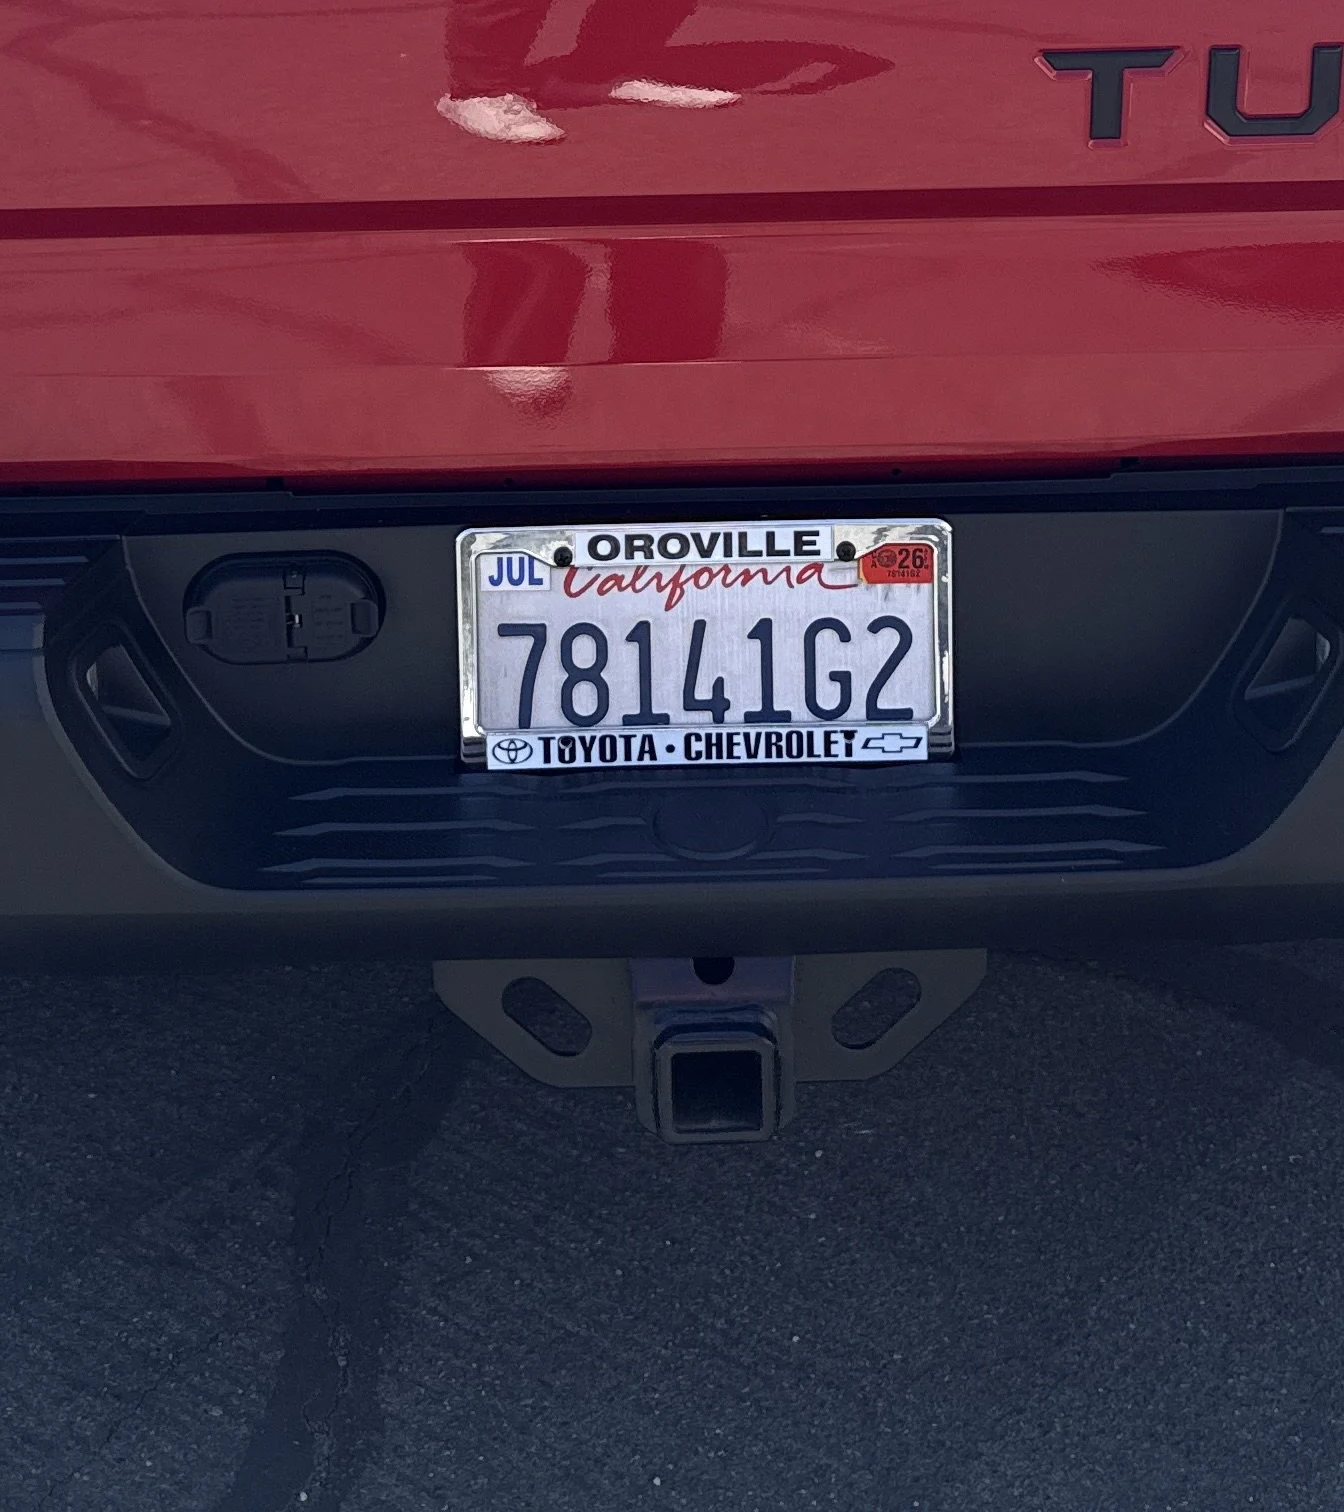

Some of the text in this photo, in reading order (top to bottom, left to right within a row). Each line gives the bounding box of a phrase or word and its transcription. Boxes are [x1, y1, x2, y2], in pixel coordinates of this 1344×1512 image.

[587, 530, 822, 561] OROVILLE
[897, 548, 924, 569] 26
[488, 555, 544, 587] JUL
[562, 561, 859, 612] California
[497, 614, 915, 729] 78141G2
[538, 728, 859, 765] TOYOTA CHEVROLET
